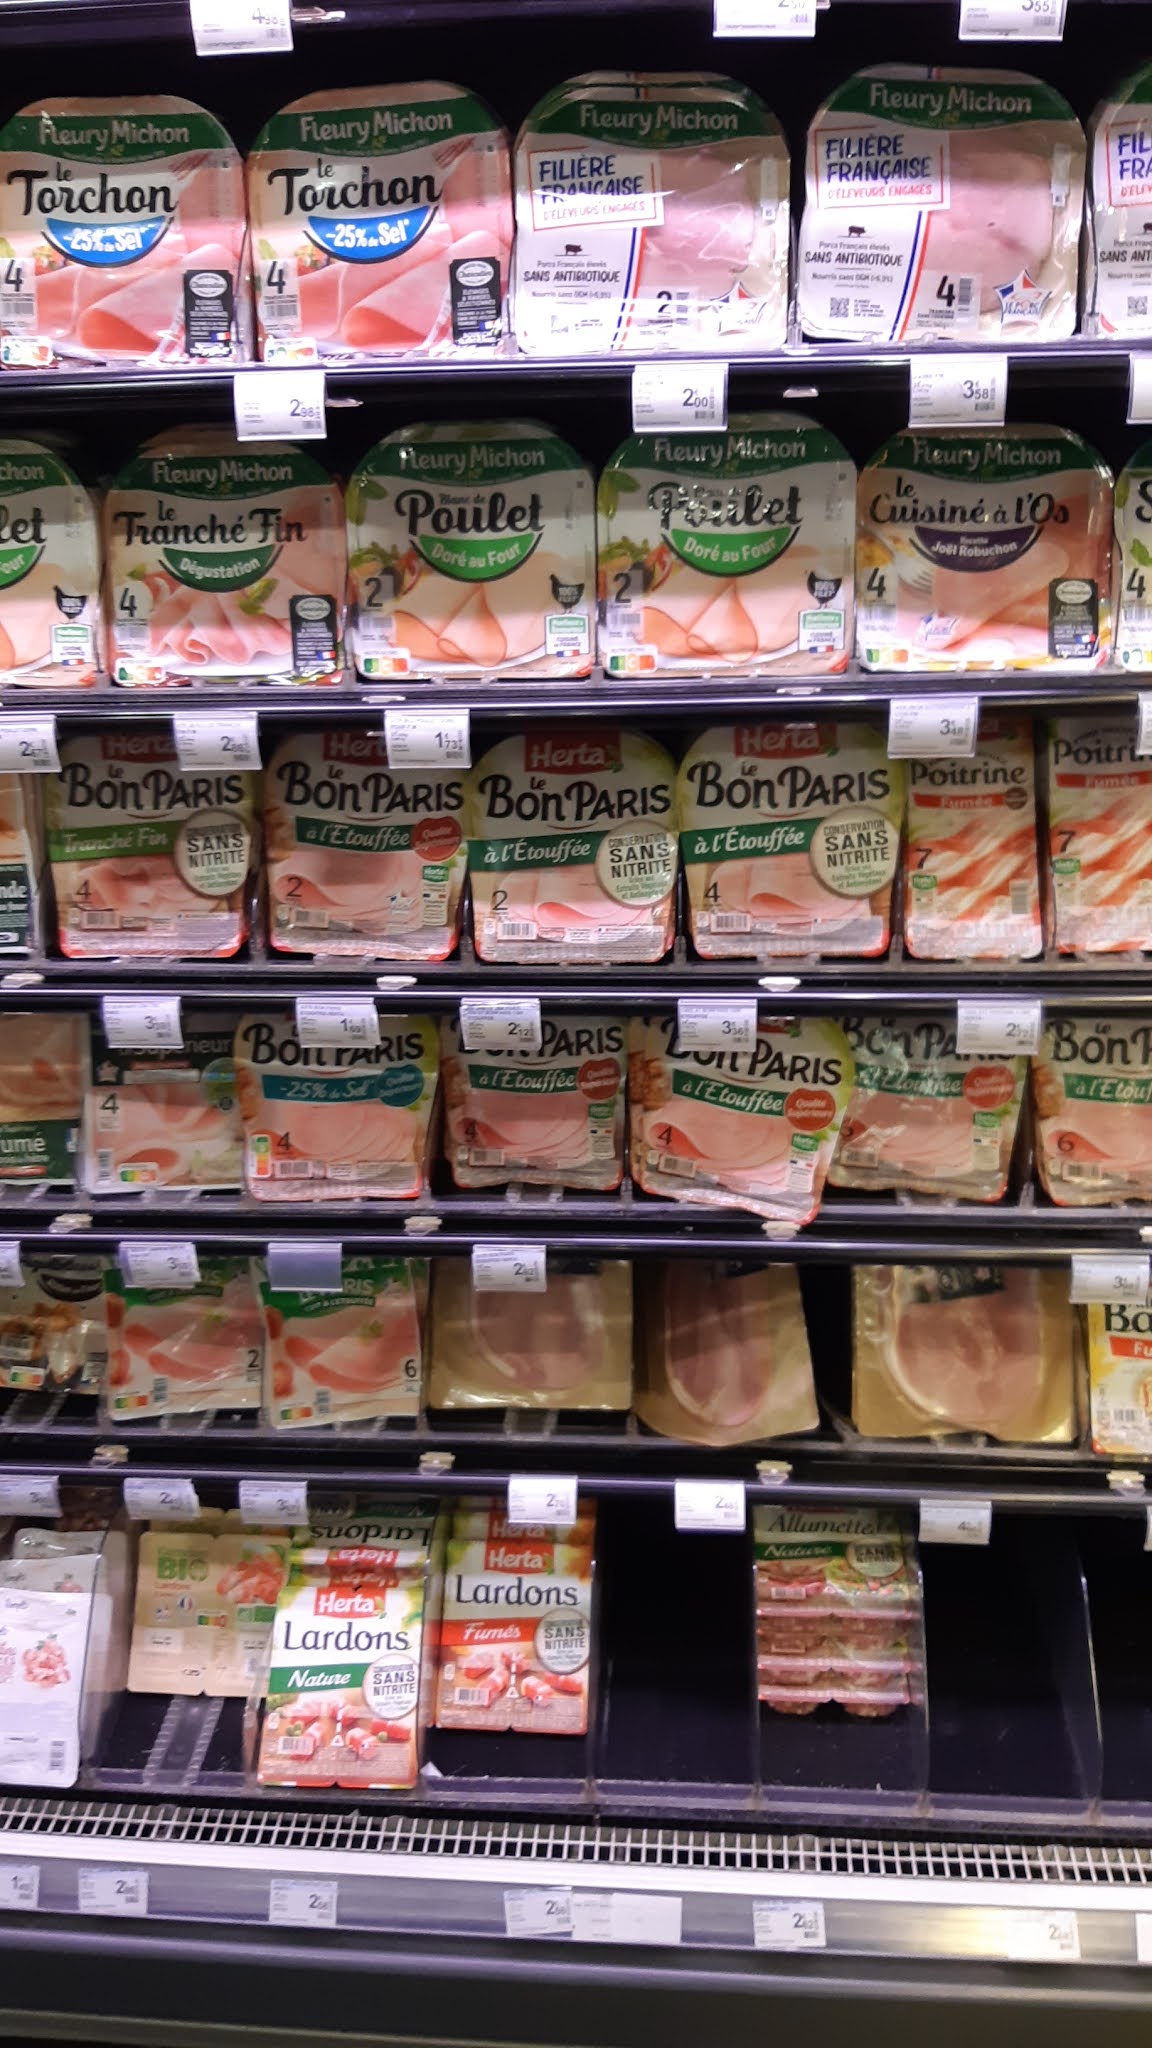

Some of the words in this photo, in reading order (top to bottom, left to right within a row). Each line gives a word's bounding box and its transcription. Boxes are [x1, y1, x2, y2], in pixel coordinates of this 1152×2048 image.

[869, 83, 944, 116] Fleury
[947, 86, 1032, 113] Michon
[300, 116, 369, 144] Fleury
[373, 111, 453, 135] Michon
[580, 104, 651, 136] Fleury
[655, 104, 738, 130] Michon
[39, 118, 109, 150] Fleury
[111, 120, 190, 145] Michon
[825, 134, 905, 160] FILIÈRE
[56, 162, 73, 181] le
[317, 158, 335, 178] le
[539, 154, 616, 183] FILIÈRE
[826, 156, 932, 184] FRANÇAISE
[7, 170, 179, 216] Torchon
[267, 166, 443, 215] Torchon
[326, 224, 366, 248] -25%
[804, 252, 832, 264] SANS
[834, 252, 903, 267] ANTIBIOTIQUE
[1099, 250, 1128, 264] SANS
[5, 259, 23, 292] 4
[267, 260, 286, 294] 4
[523, 271, 550, 283] SANS
[553, 270, 621, 284] ANTIBIOTIQUE
[656, 290, 672, 313] 2
[935, 275, 955, 307] 4
[469, 446, 545, 468] Michon
[654, 438, 723, 467] Fleury
[726, 436, 806, 460] Michon
[912, 439, 981, 470] Fleury
[983, 442, 1061, 466] Michon
[153, 461, 218, 488] Fleury
[220, 461, 293, 482] Michon
[896, 476, 915, 498] le
[158, 500, 175, 521] le
[395, 489, 546, 537] Poulet
[648, 481, 804, 531] Poulet
[870, 492, 985, 524] Cuisiné
[994, 504, 1007, 524] à
[1015, 492, 1070, 524] l'Os
[114, 511, 244, 545] Tranché
[249, 508, 308, 543] Fin
[431, 543, 466, 568] Doré
[468, 557, 486, 569] au
[487, 543, 521, 566] Four
[684, 537, 719, 562] Doré
[722, 551, 740, 563] au
[742, 537, 777, 561] Four
[931, 542, 958, 556] Joël
[959, 541, 1018, 558] Robuchon
[179, 556, 261, 579] Dégustation
[364, 577, 383, 608] 2
[613, 572, 632, 604] 2
[867, 568, 886, 598] 4
[1126, 568, 1146, 598] 4
[120, 587, 137, 618] 4
[741, 726, 820, 751] Herta
[530, 741, 606, 768] Herta
[107, 764, 124, 779] le
[328, 765, 343, 779] le
[741, 761, 758, 777] le
[910, 761, 1027, 786] Poitrine
[57, 763, 144, 810] Bon
[142, 769, 245, 810] PARIS
[276, 760, 362, 813] Bon
[361, 772, 464, 814] PARIS
[530, 776, 546, 790] le
[686, 760, 778, 809] Bon
[777, 765, 891, 808] PARIS
[478, 774, 565, 822] Bon
[564, 781, 672, 822] PARIS
[306, 827, 317, 840] à
[823, 819, 885, 836] CONSERVATION
[63, 830, 133, 853] Tranché
[138, 829, 169, 849] Fin
[187, 832, 245, 854] SANS
[483, 846, 499, 863] à
[501, 839, 592, 863] l'Étouffée
[608, 832, 667, 848] CONSERVATION
[694, 836, 709, 855] à
[712, 826, 806, 853] l'Étouffée
[824, 829, 889, 851] SANS
[1058, 831, 1076, 853] 7
[187, 849, 246, 869] NITRITE
[609, 842, 671, 864] SANS
[827, 847, 891, 868] NITRITE
[915, 848, 932, 869] 7
[611, 859, 673, 879] NITRITE
[76, 880, 92, 901] 4
[287, 877, 303, 898] 2
[704, 882, 720, 903] 4
[492, 890, 508, 911] 2
[1095, 1021, 1111, 1034] le
[538, 1021, 624, 1057] PARIS
[1045, 1019, 1131, 1065] Bon
[749, 1039, 842, 1086] PARIS
[280, 1080, 327, 1098] -25%
[479, 1075, 489, 1086] à
[1075, 1083, 1085, 1096] à
[100, 1092, 119, 1115] 4
[682, 1080, 693, 1094] à
[695, 1081, 784, 1112] l'Etouffée
[277, 1131, 291, 1150] 4
[657, 1126, 673, 1146] 4
[1058, 1131, 1075, 1152] 6
[247, 1350, 258, 1368] 2
[405, 1359, 417, 1378] 6
[310, 1524, 430, 1547] Lardons
[492, 1523, 545, 1538] Herta
[338, 1549, 394, 1562] Herta
[489, 1548, 543, 1569] Herta
[764, 1544, 833, 1557] Nature
[157, 1557, 209, 1582] BIO
[456, 1574, 581, 1606] Lardons
[318, 1592, 375, 1614] Herta
[284, 1621, 412, 1651] Lardons
[463, 1621, 522, 1641] Fumés
[544, 1626, 585, 1638] SANS
[544, 1637, 586, 1650] NITRITE
[288, 1669, 351, 1688] Nature
[373, 1671, 415, 1685] SANS
[373, 1683, 416, 1697] NITRITE
